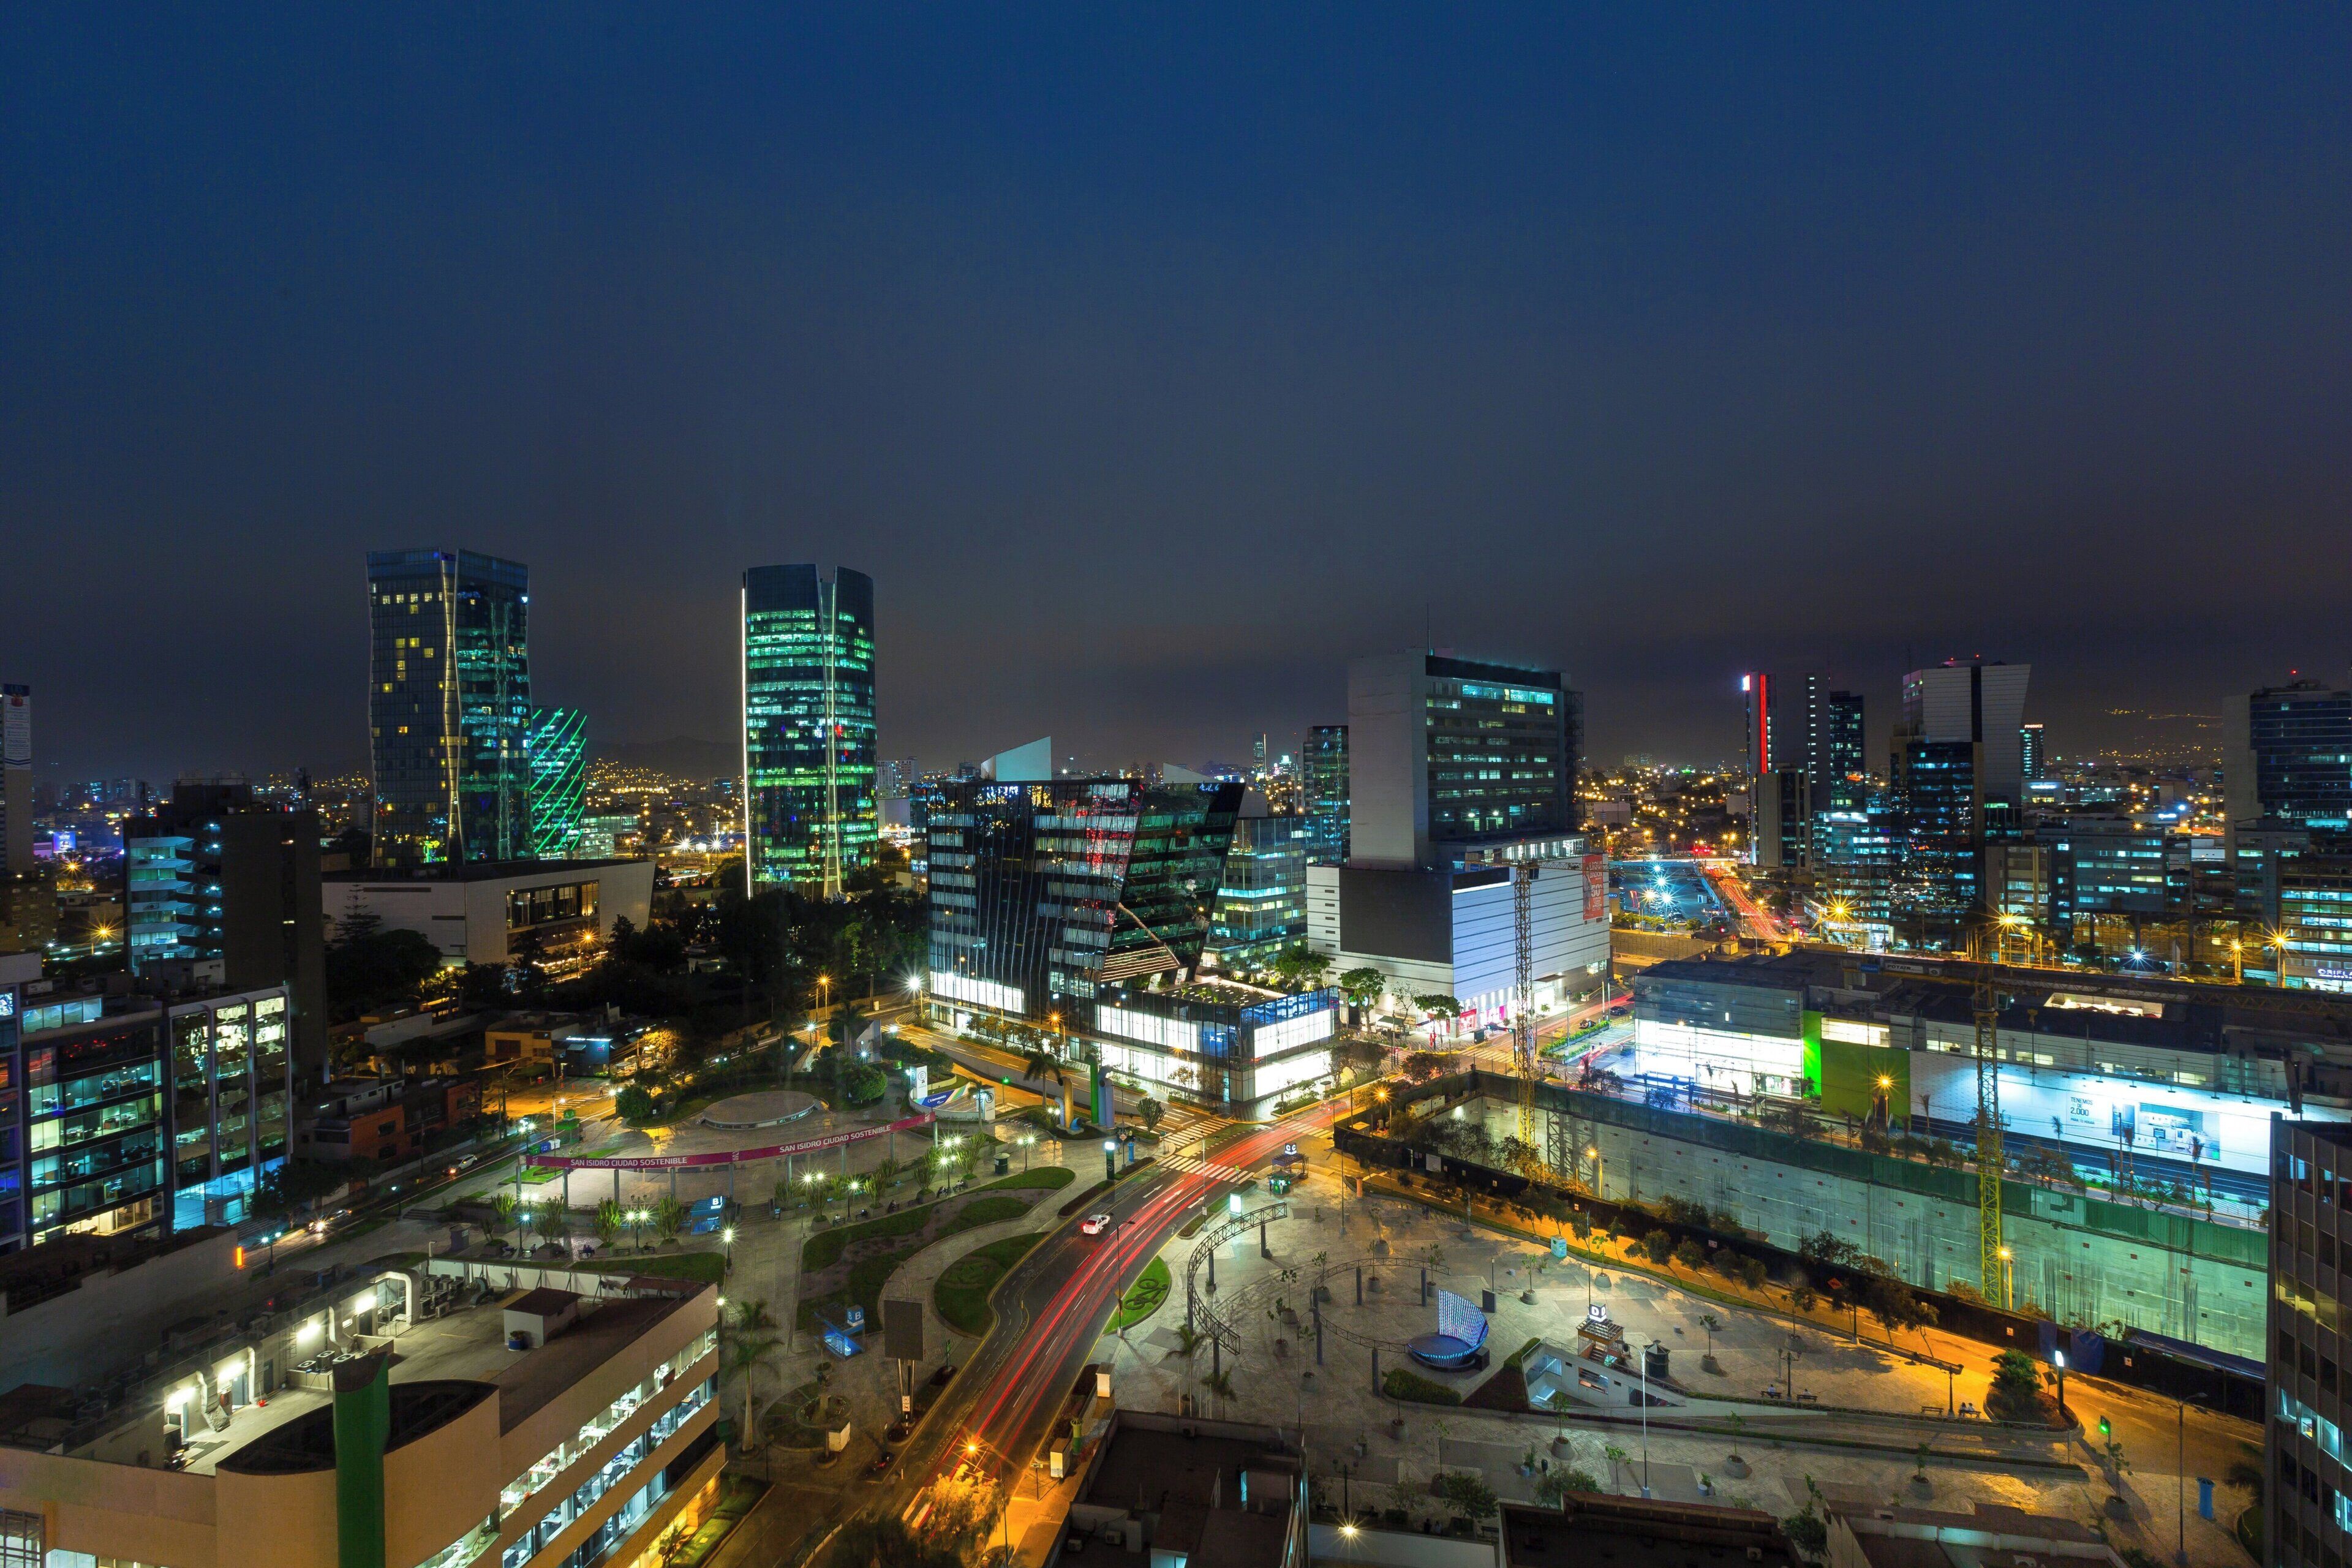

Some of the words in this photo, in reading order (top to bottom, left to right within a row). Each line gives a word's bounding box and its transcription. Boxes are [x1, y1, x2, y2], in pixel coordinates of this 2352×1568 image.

[2070, 1107, 2089, 1116] 2,000
[797, 1140, 821, 1149] ISIDRO
[823, 1134, 849, 1145] CIUDAD
[850, 1125, 891, 1140] SOSTENIBLE
[639, 1157, 687, 1166] SOSTENIBLE
[855, 1311, 861, 1320] B
[1591, 1306, 1599, 1316] D
